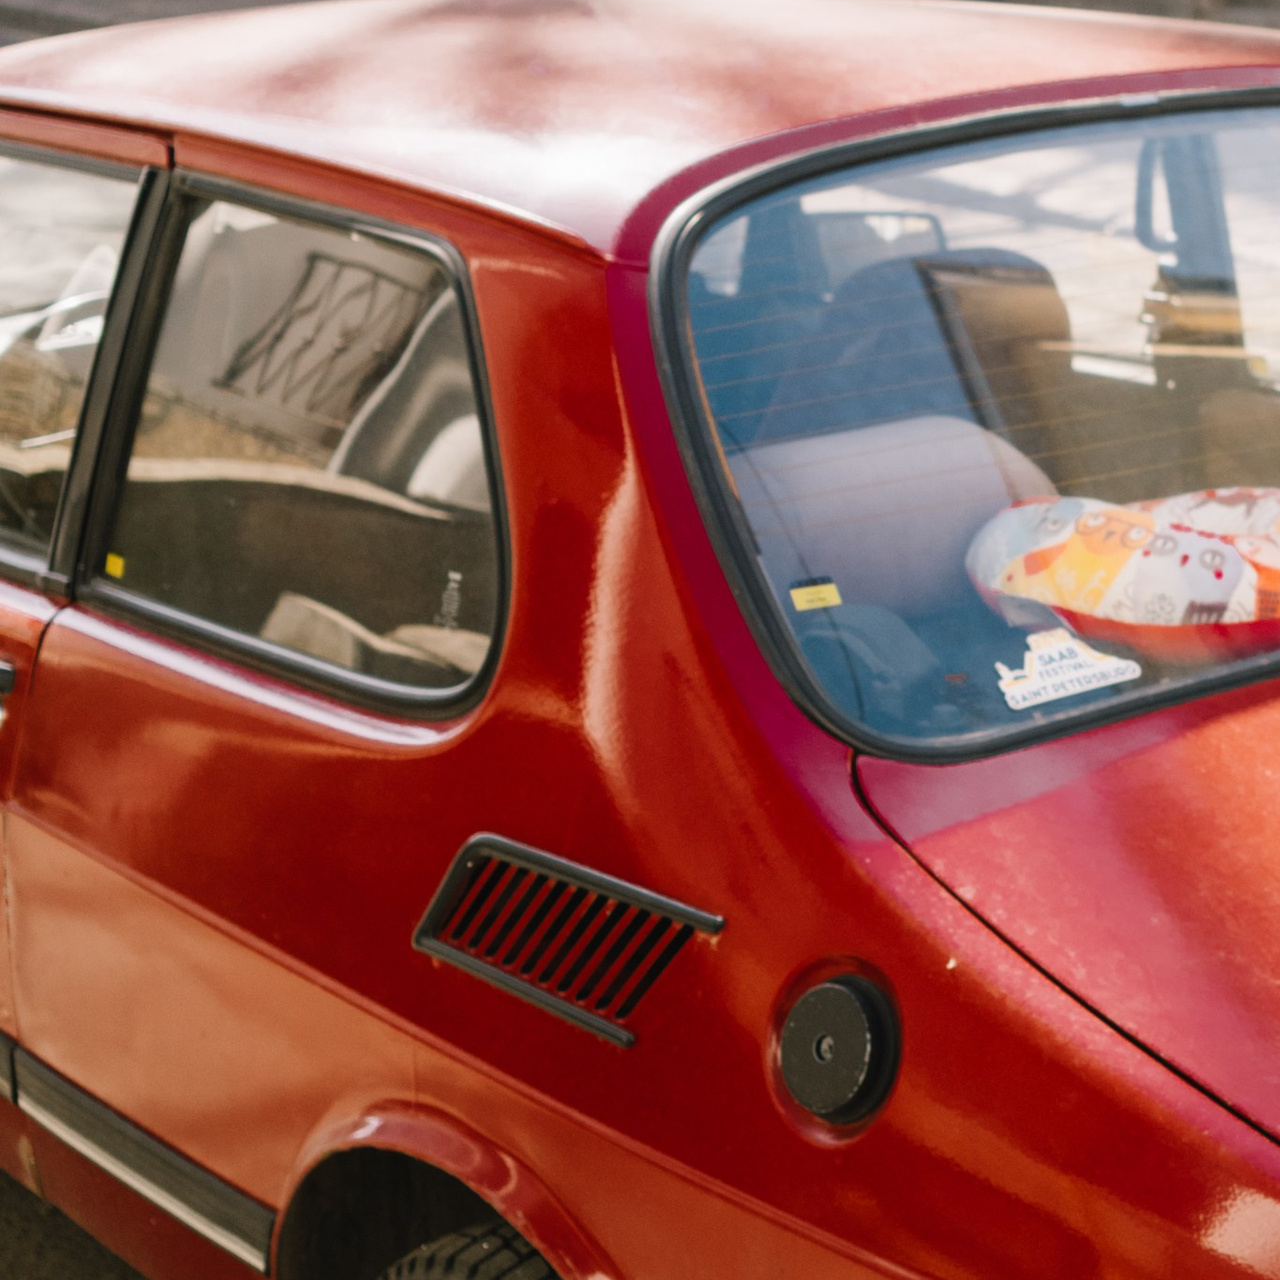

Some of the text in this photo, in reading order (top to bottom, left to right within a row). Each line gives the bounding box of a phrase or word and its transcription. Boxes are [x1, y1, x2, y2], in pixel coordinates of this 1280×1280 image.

[1037, 647, 1079, 667] SAAB
[1039, 660, 1094, 681] FESTIVAL
[1010, 663, 1137, 705] SAINT PETERSBURG
